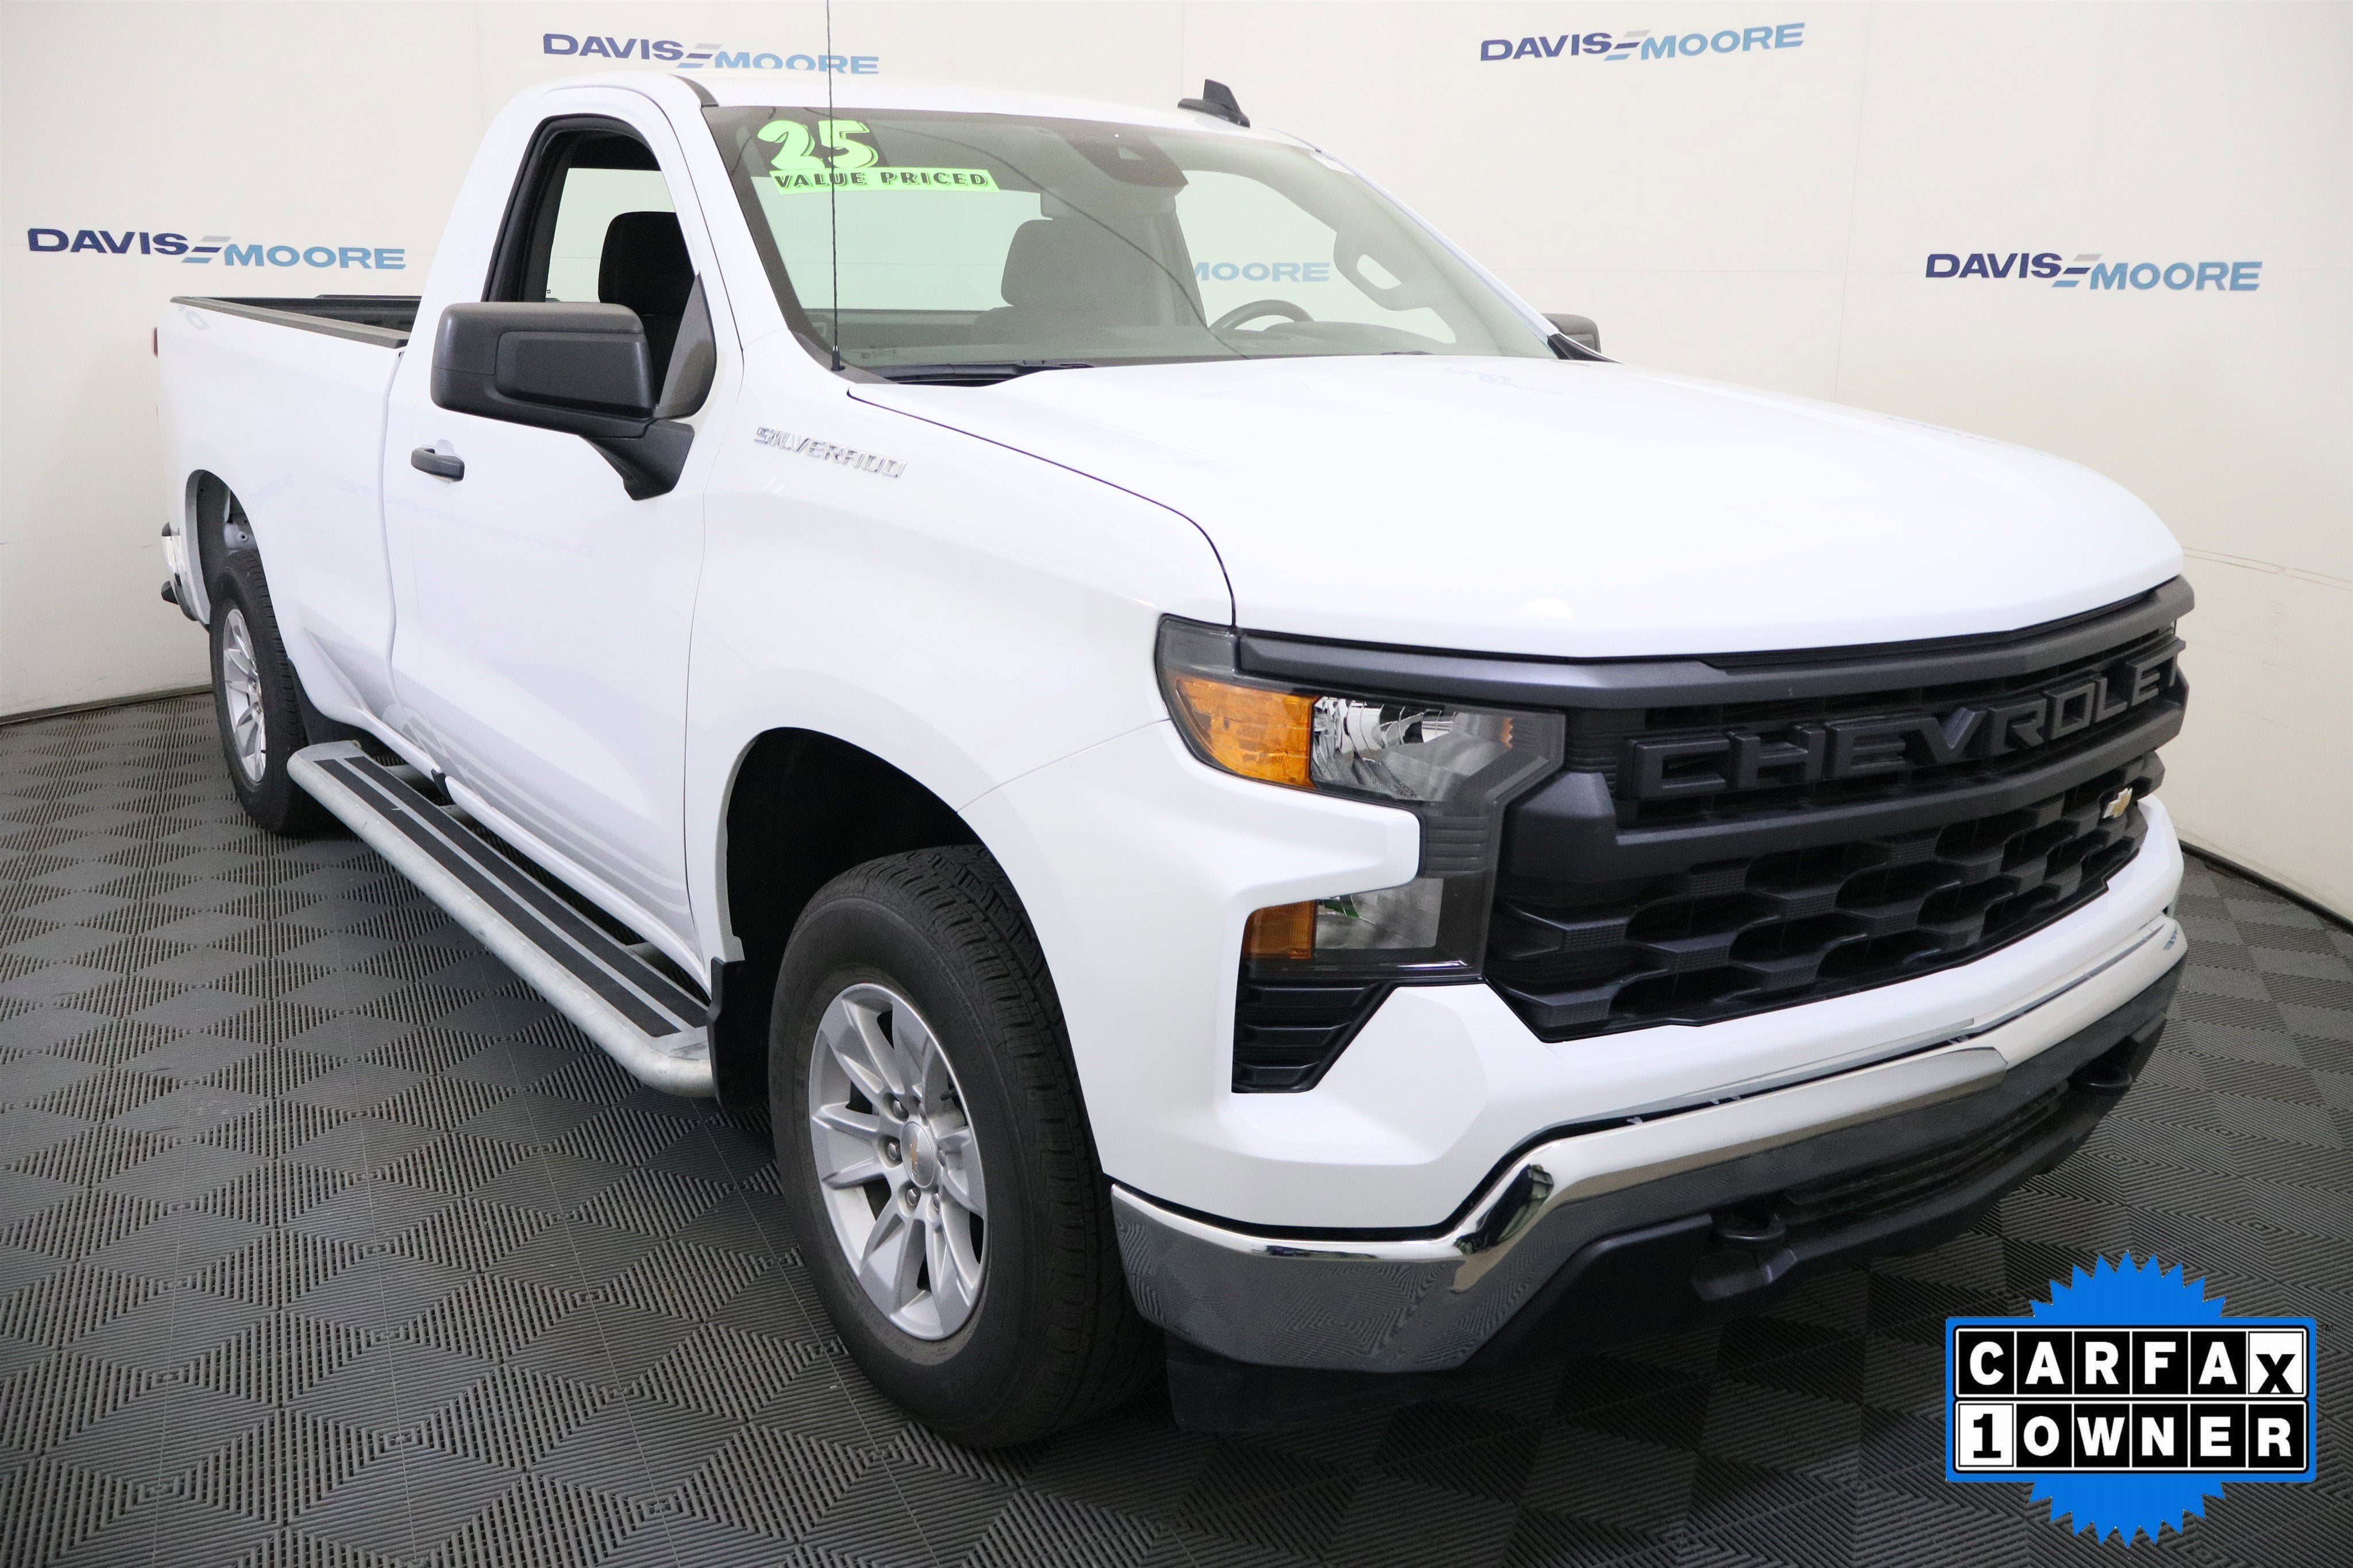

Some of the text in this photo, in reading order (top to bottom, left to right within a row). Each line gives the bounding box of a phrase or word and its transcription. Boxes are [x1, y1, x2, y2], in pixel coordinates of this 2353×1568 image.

[543, 33, 879, 75] DAVIS MOORE
[1480, 22, 1806, 61] DAVIS MOORE
[757, 120, 879, 171] 25
[774, 171, 988, 188] VALUE PRICED
[27, 228, 406, 270] DAVIS MOORE
[1925, 252, 2263, 291] DAVIS MOORE
[753, 426, 908, 479] SILVERADO
[1627, 638, 2186, 801] CHEVROLET
